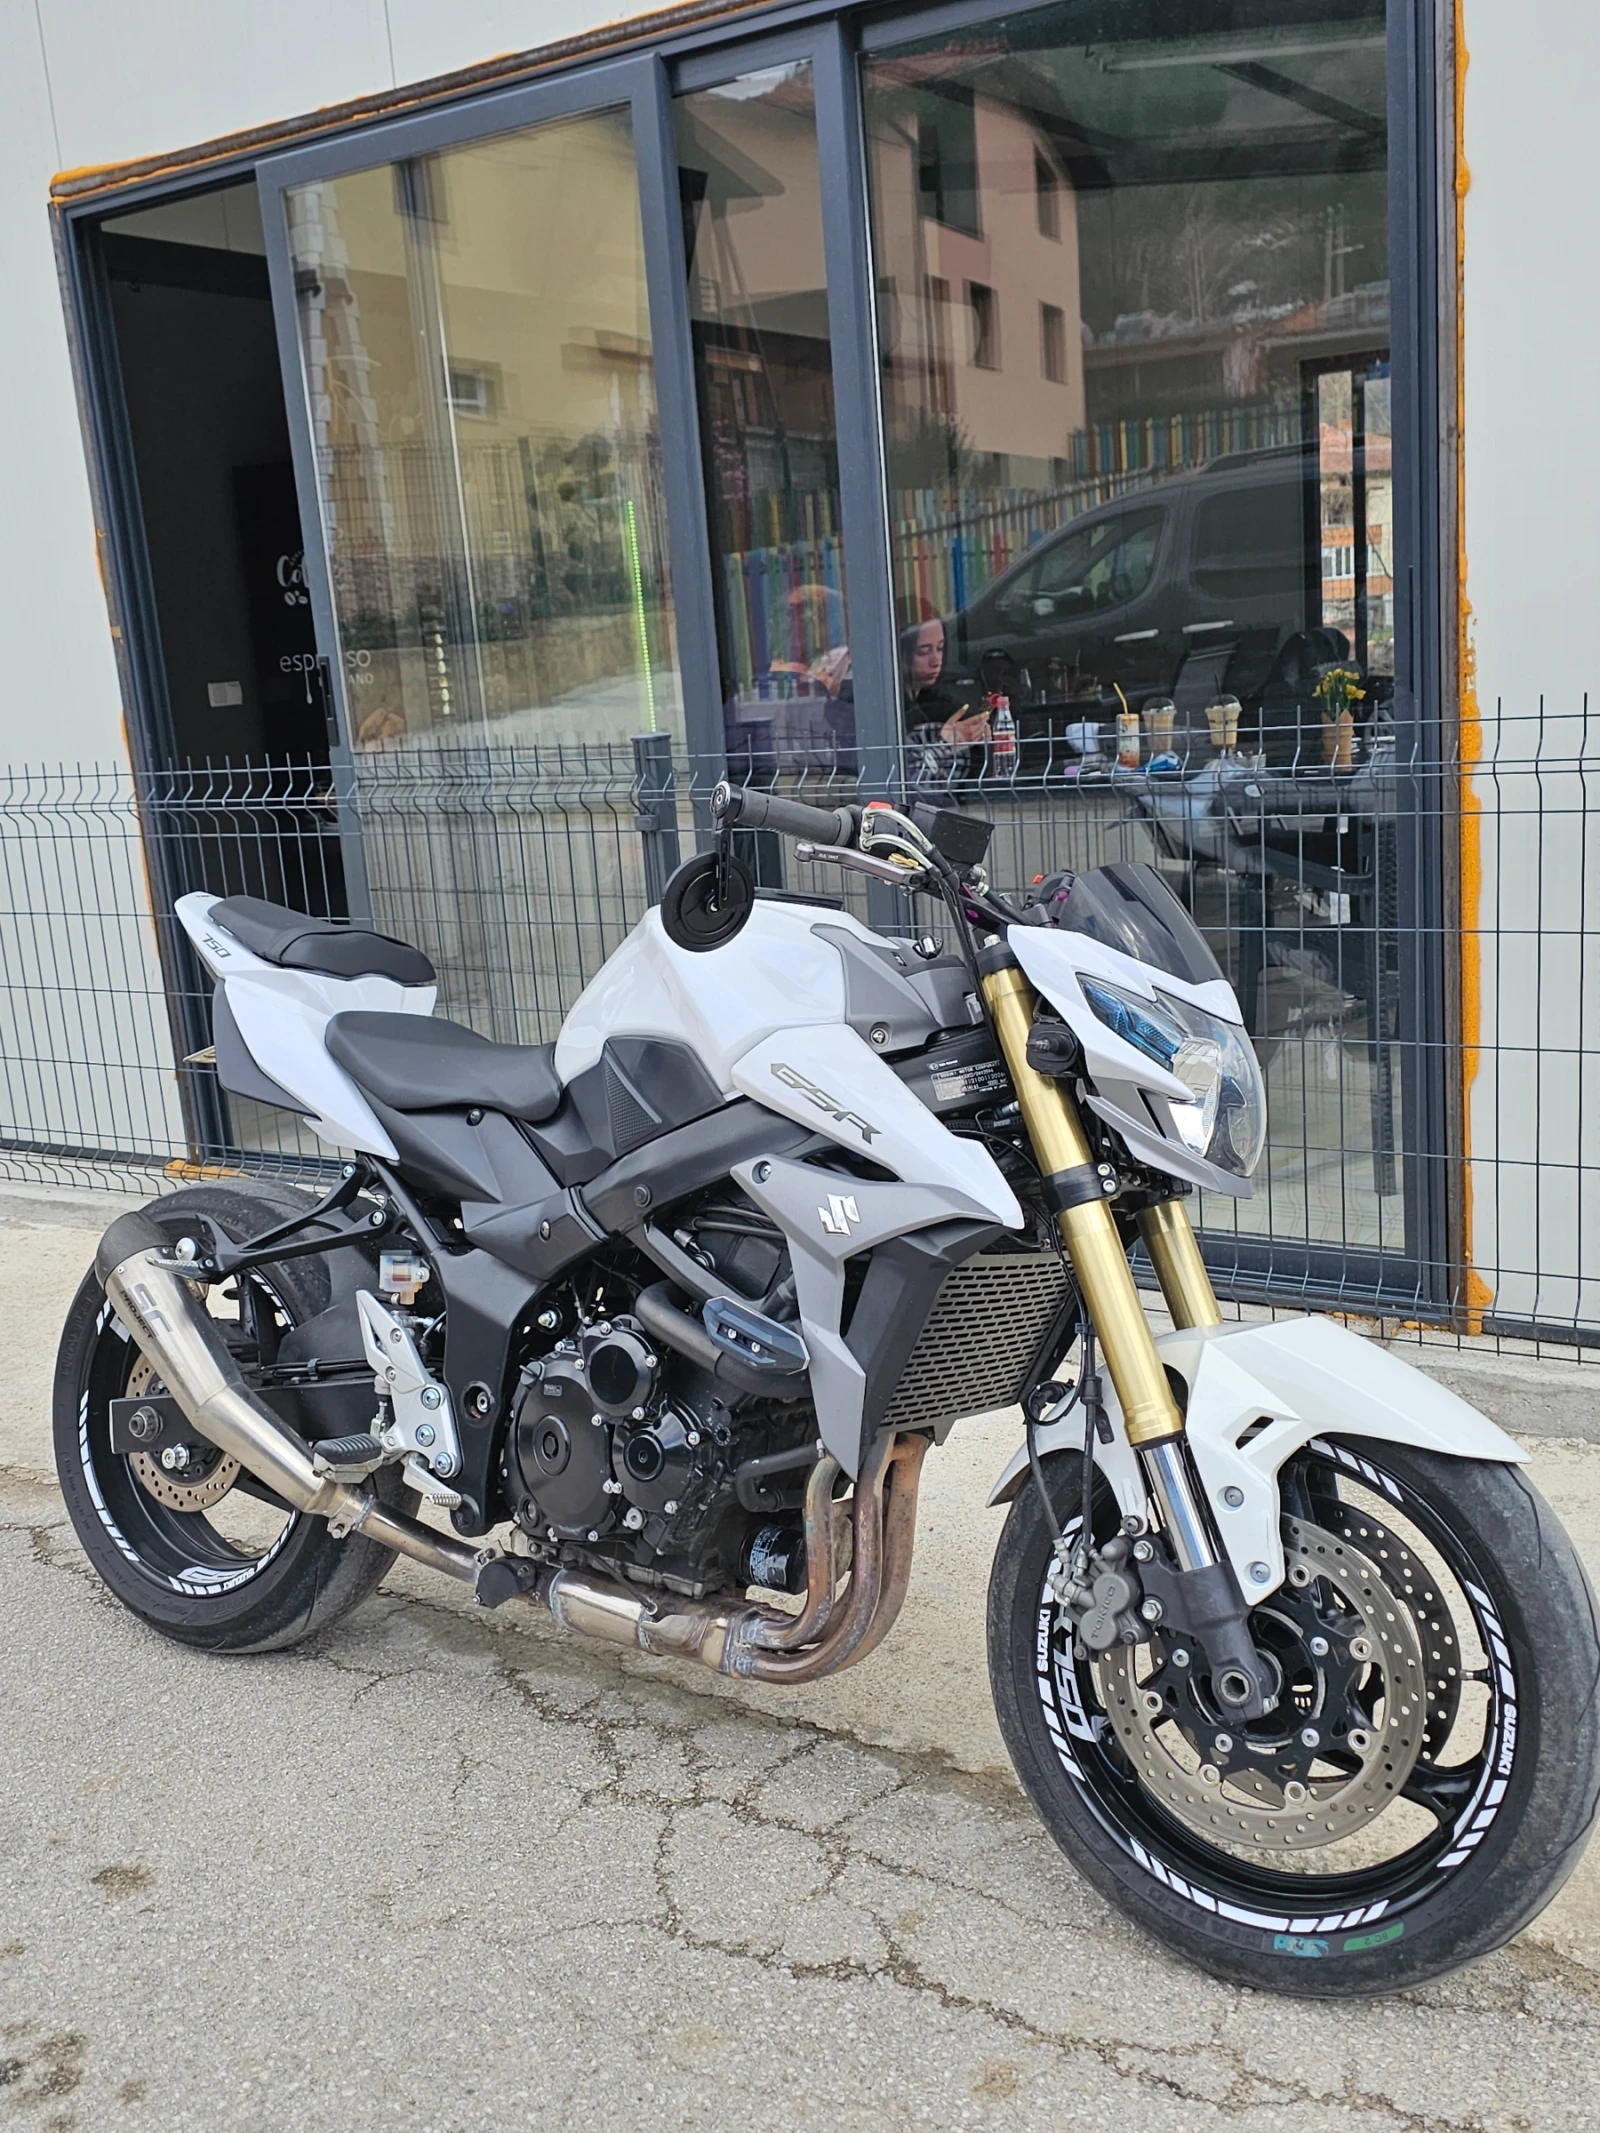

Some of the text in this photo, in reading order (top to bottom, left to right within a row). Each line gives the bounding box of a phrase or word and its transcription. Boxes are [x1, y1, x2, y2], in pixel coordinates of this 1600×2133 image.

[202, 932, 232, 959] 750
[771, 1063, 883, 1145] GSR
[120, 1289, 155, 1340] PROJECT
[1036, 1608, 1052, 1673] SUZUKI
[1091, 1585, 1116, 1640] TOKICO
[1053, 1633, 1098, 1744] 750
[1497, 1703, 1518, 1776] SUZUKI
